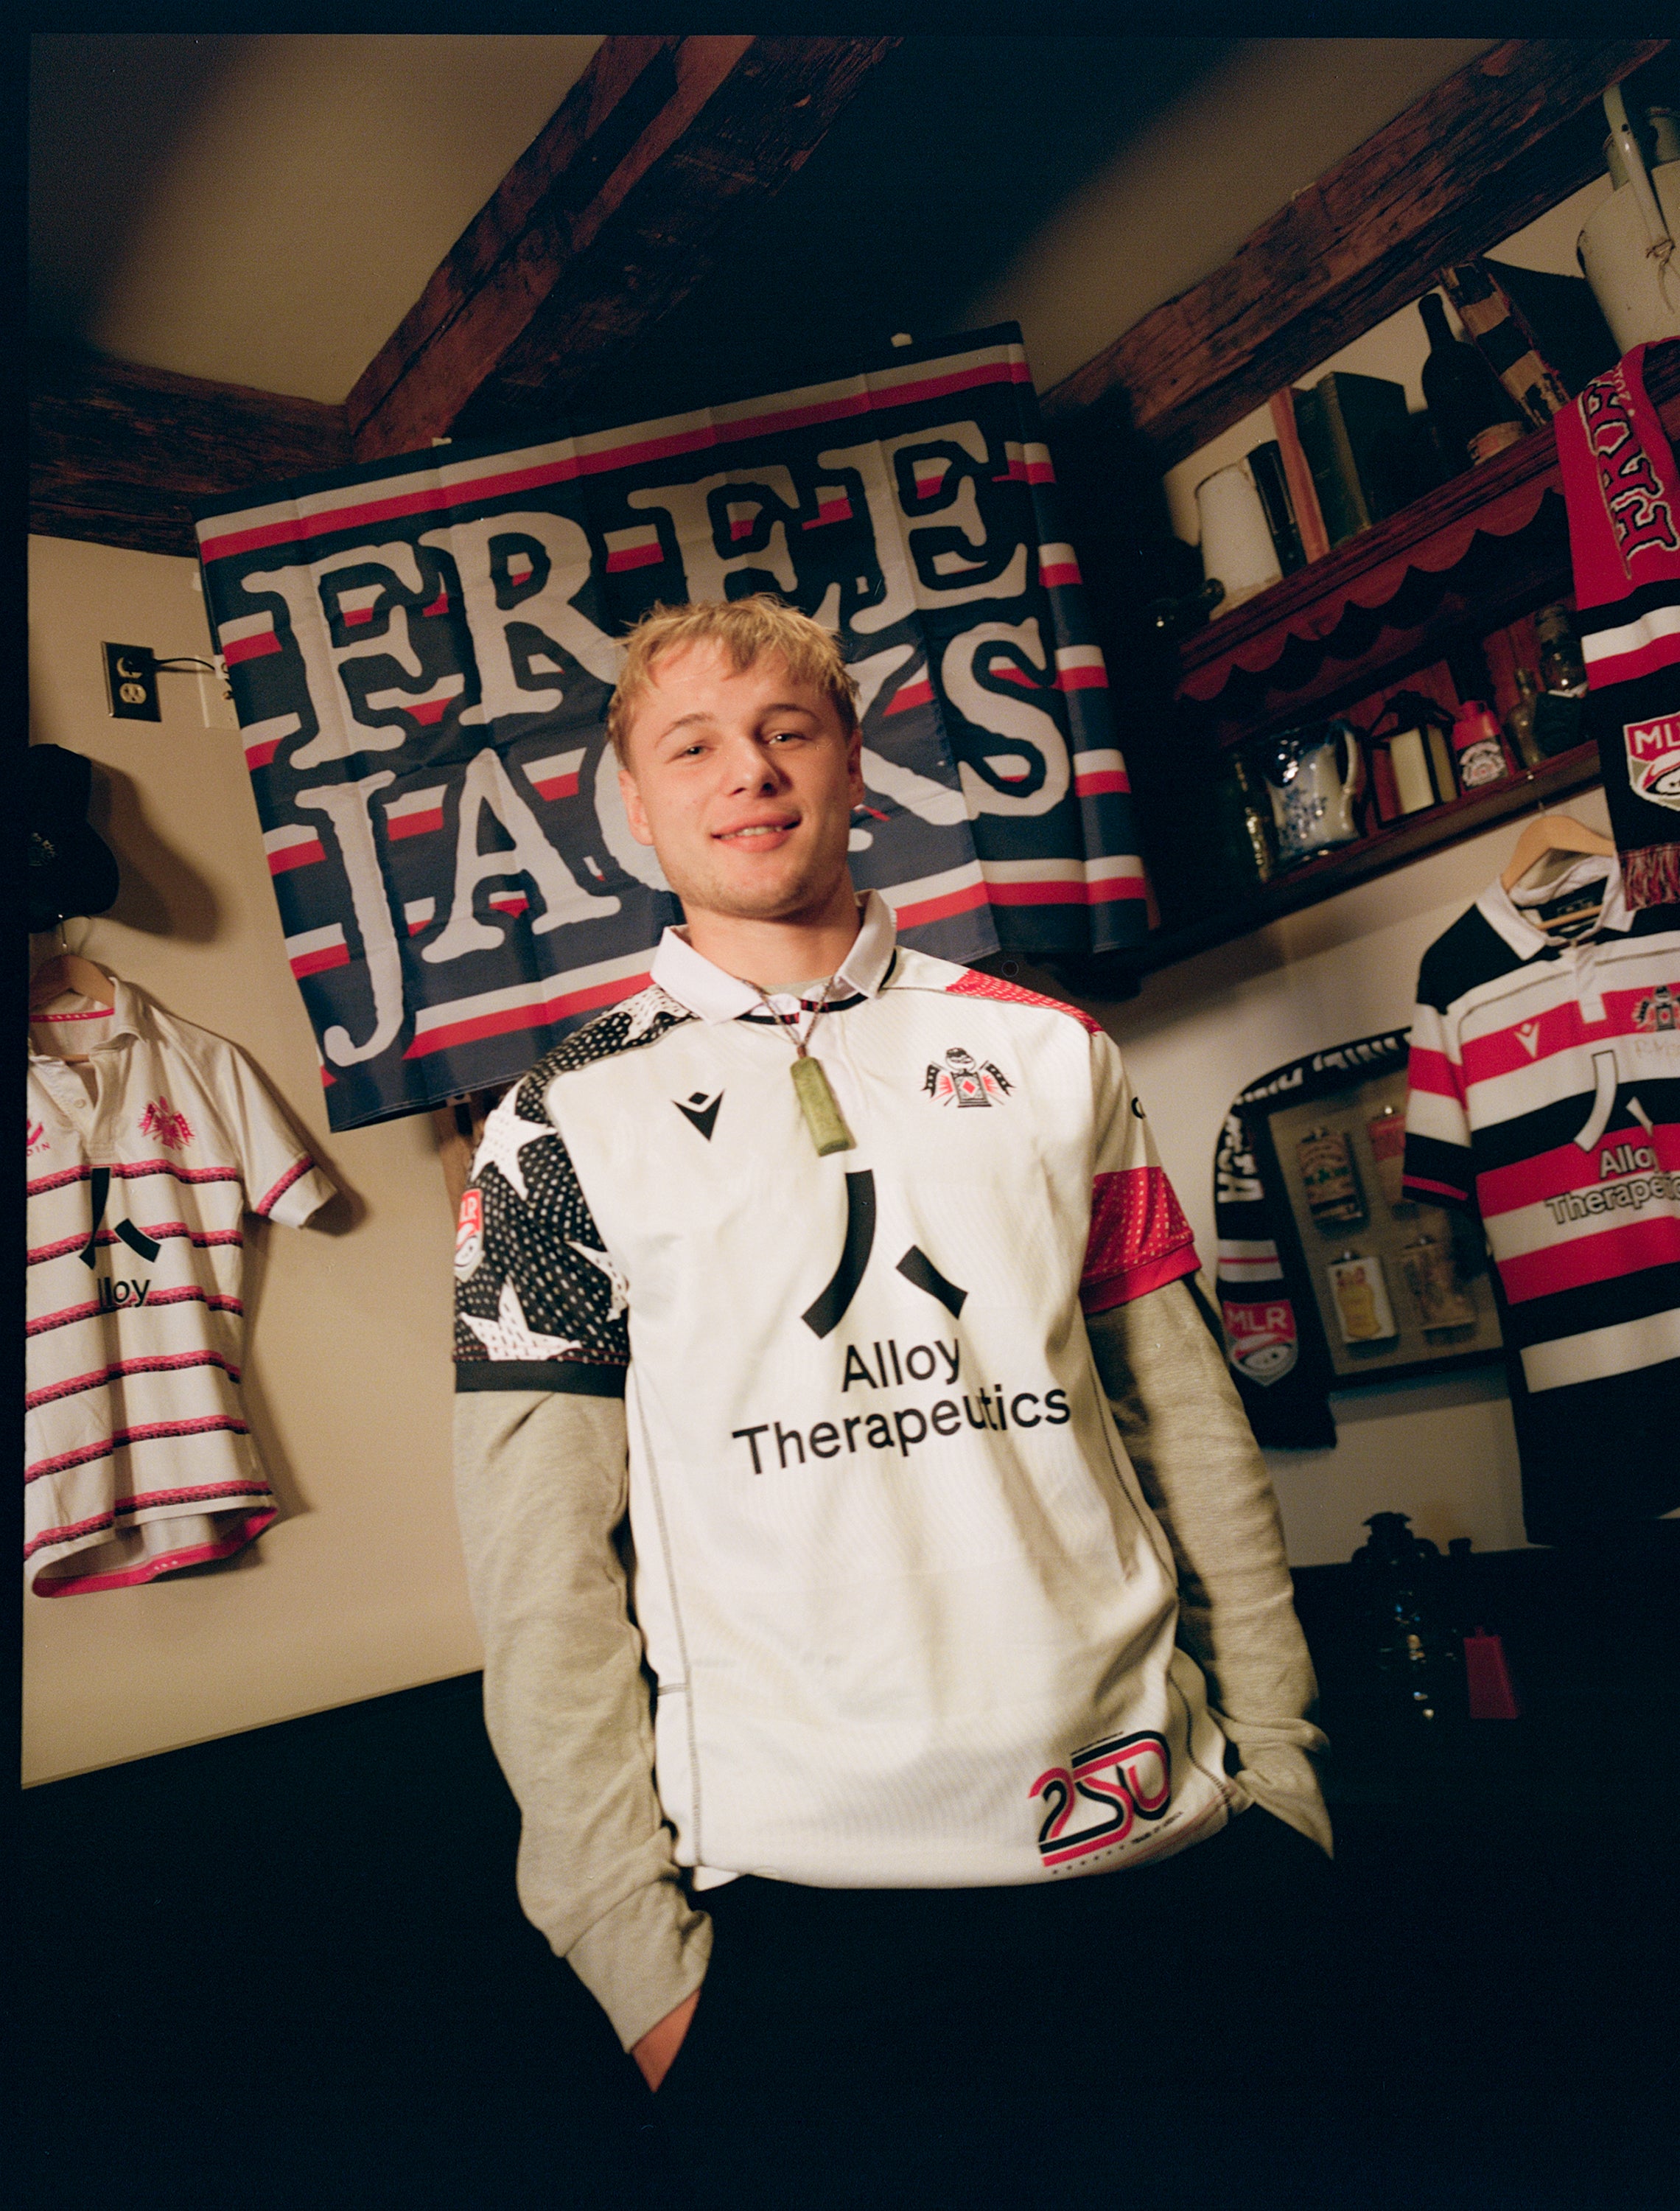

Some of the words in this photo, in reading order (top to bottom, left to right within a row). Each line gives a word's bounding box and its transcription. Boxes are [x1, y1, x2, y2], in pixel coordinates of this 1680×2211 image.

[242, 420, 1029, 771] FREE
[1634, 721, 1680, 755] ML
[1598, 1143, 1659, 1180] Allo
[97, 1276, 151, 1308] lloy
[1225, 1306, 1289, 1332] MLR
[841, 1338, 959, 1393] Alloy
[732, 1383, 1071, 1475] Therapeutics
[1027, 1730, 1172, 1868] 250
